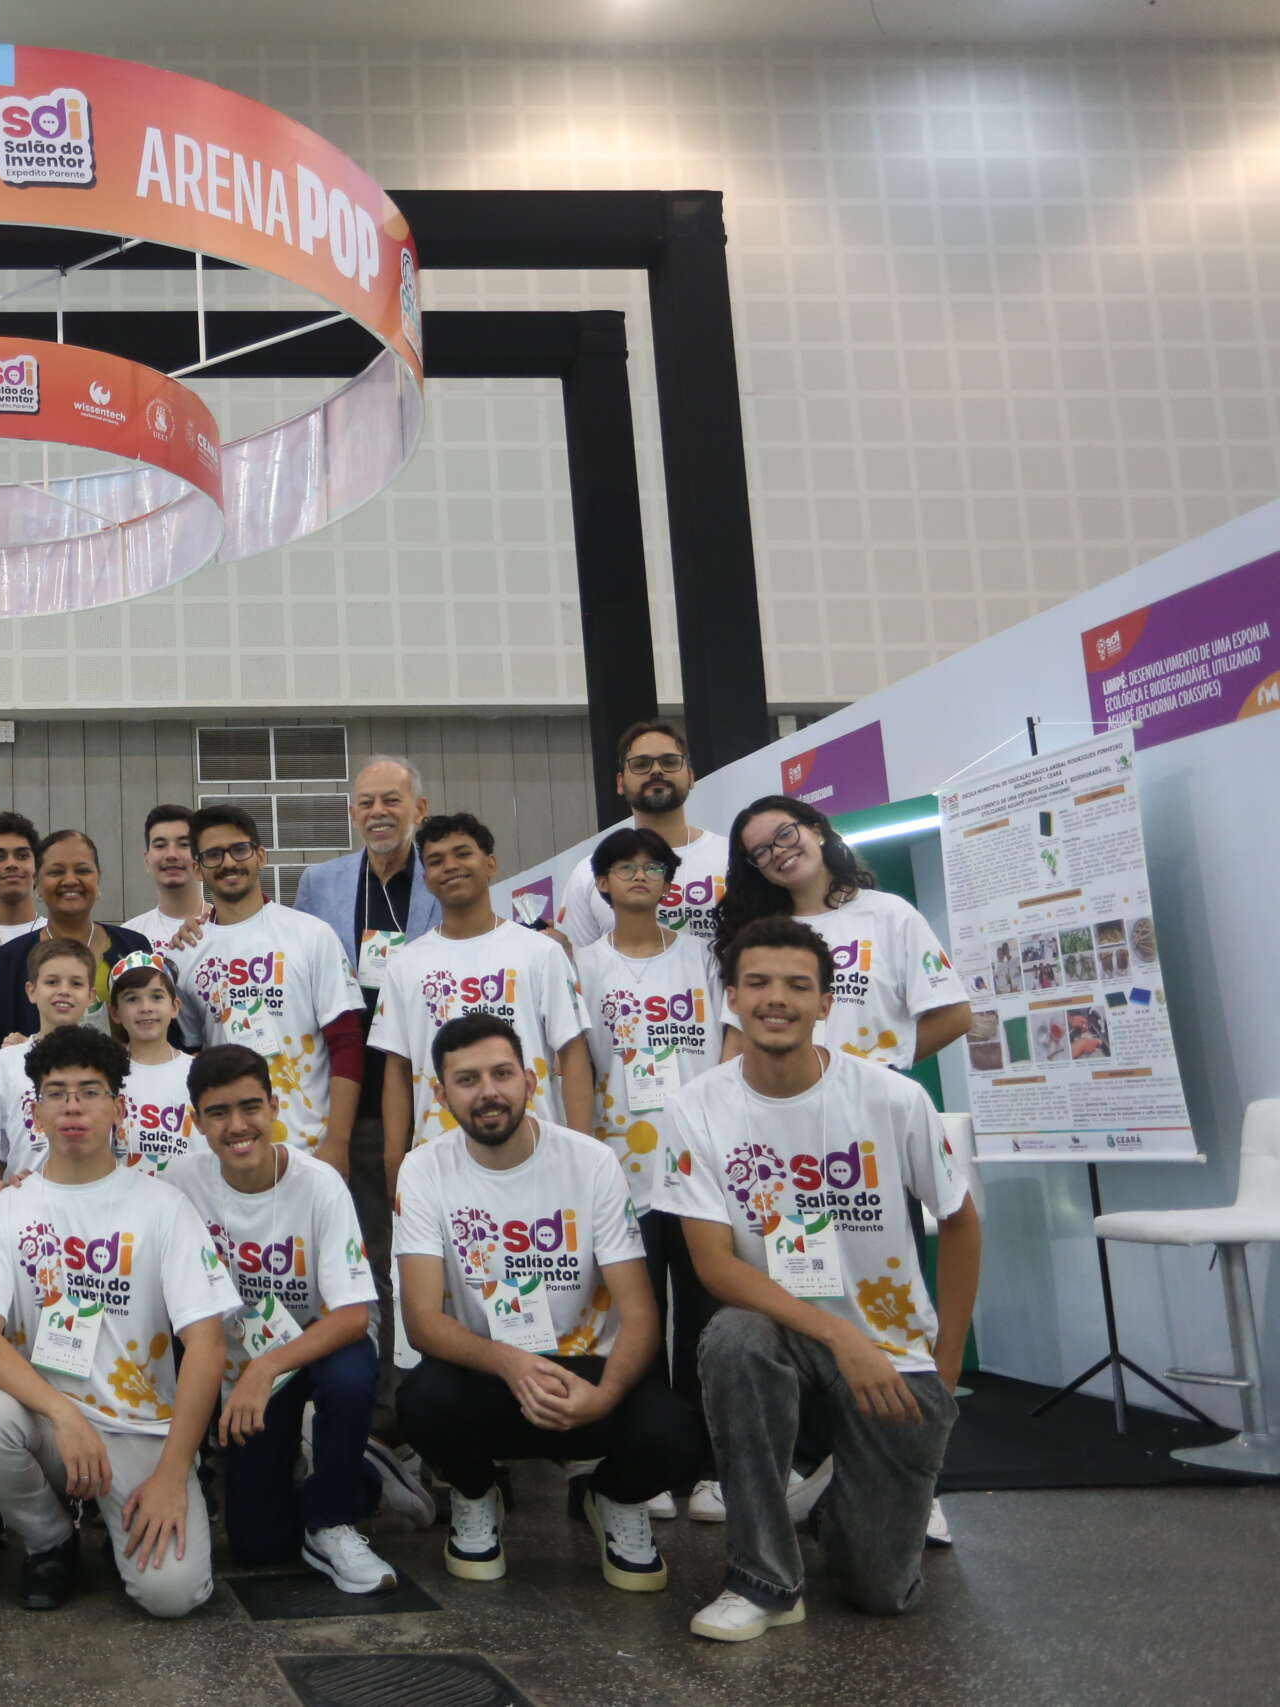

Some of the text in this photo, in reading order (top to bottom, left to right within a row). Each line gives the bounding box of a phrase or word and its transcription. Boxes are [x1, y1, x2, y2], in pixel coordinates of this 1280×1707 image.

[2, 98, 83, 141] sdi
[4, 140, 84, 156] Salão do
[5, 153, 86, 169] Inventor
[6, 168, 86, 180] Expedito Parente
[136, 126, 380, 292] ARENA POP
[20, 386, 34, 396] do
[73, 402, 126, 422] wissentech
[1129, 650, 1199, 686] DESENVOLVIMENTO
[1199, 644, 1211, 660] DE
[1211, 637, 1232, 656] UMA
[1232, 622, 1270, 649] ESPONJA
[1105, 686, 1144, 713] ECOLÓGICA
[1150, 662, 1211, 698] BIODEGRADÁVEL
[1211, 646, 1261, 675] UTILIZANDO
[1179, 680, 1222, 707] CRASSIPES)
[830, 940, 872, 972] di
[229, 952, 285, 985] sdi
[460, 968, 516, 1003] sdi
[849, 972, 869, 985] do
[266, 986, 283, 997] do
[830, 983, 868, 997] entor
[497, 1005, 514, 1016] do
[644, 988, 705, 1023] sdi
[837, 997, 865, 1006] Parente
[646, 1023, 705, 1036] Salão do
[648, 1035, 706, 1047] Inventor
[140, 1103, 193, 1137] sdi
[789, 1140, 879, 1190] sdi
[795, 1190, 881, 1209] Salão do
[797, 1206, 883, 1222] entor
[502, 1208, 577, 1252] sdi
[842, 1223, 884, 1233] Parente
[64, 1231, 134, 1276] sdi
[237, 1235, 307, 1277] sdi
[557, 1254, 578, 1268] do
[67, 1272, 130, 1291] Salão do
[238, 1274, 307, 1290] Salão do
[546, 1283, 581, 1292] Parente
